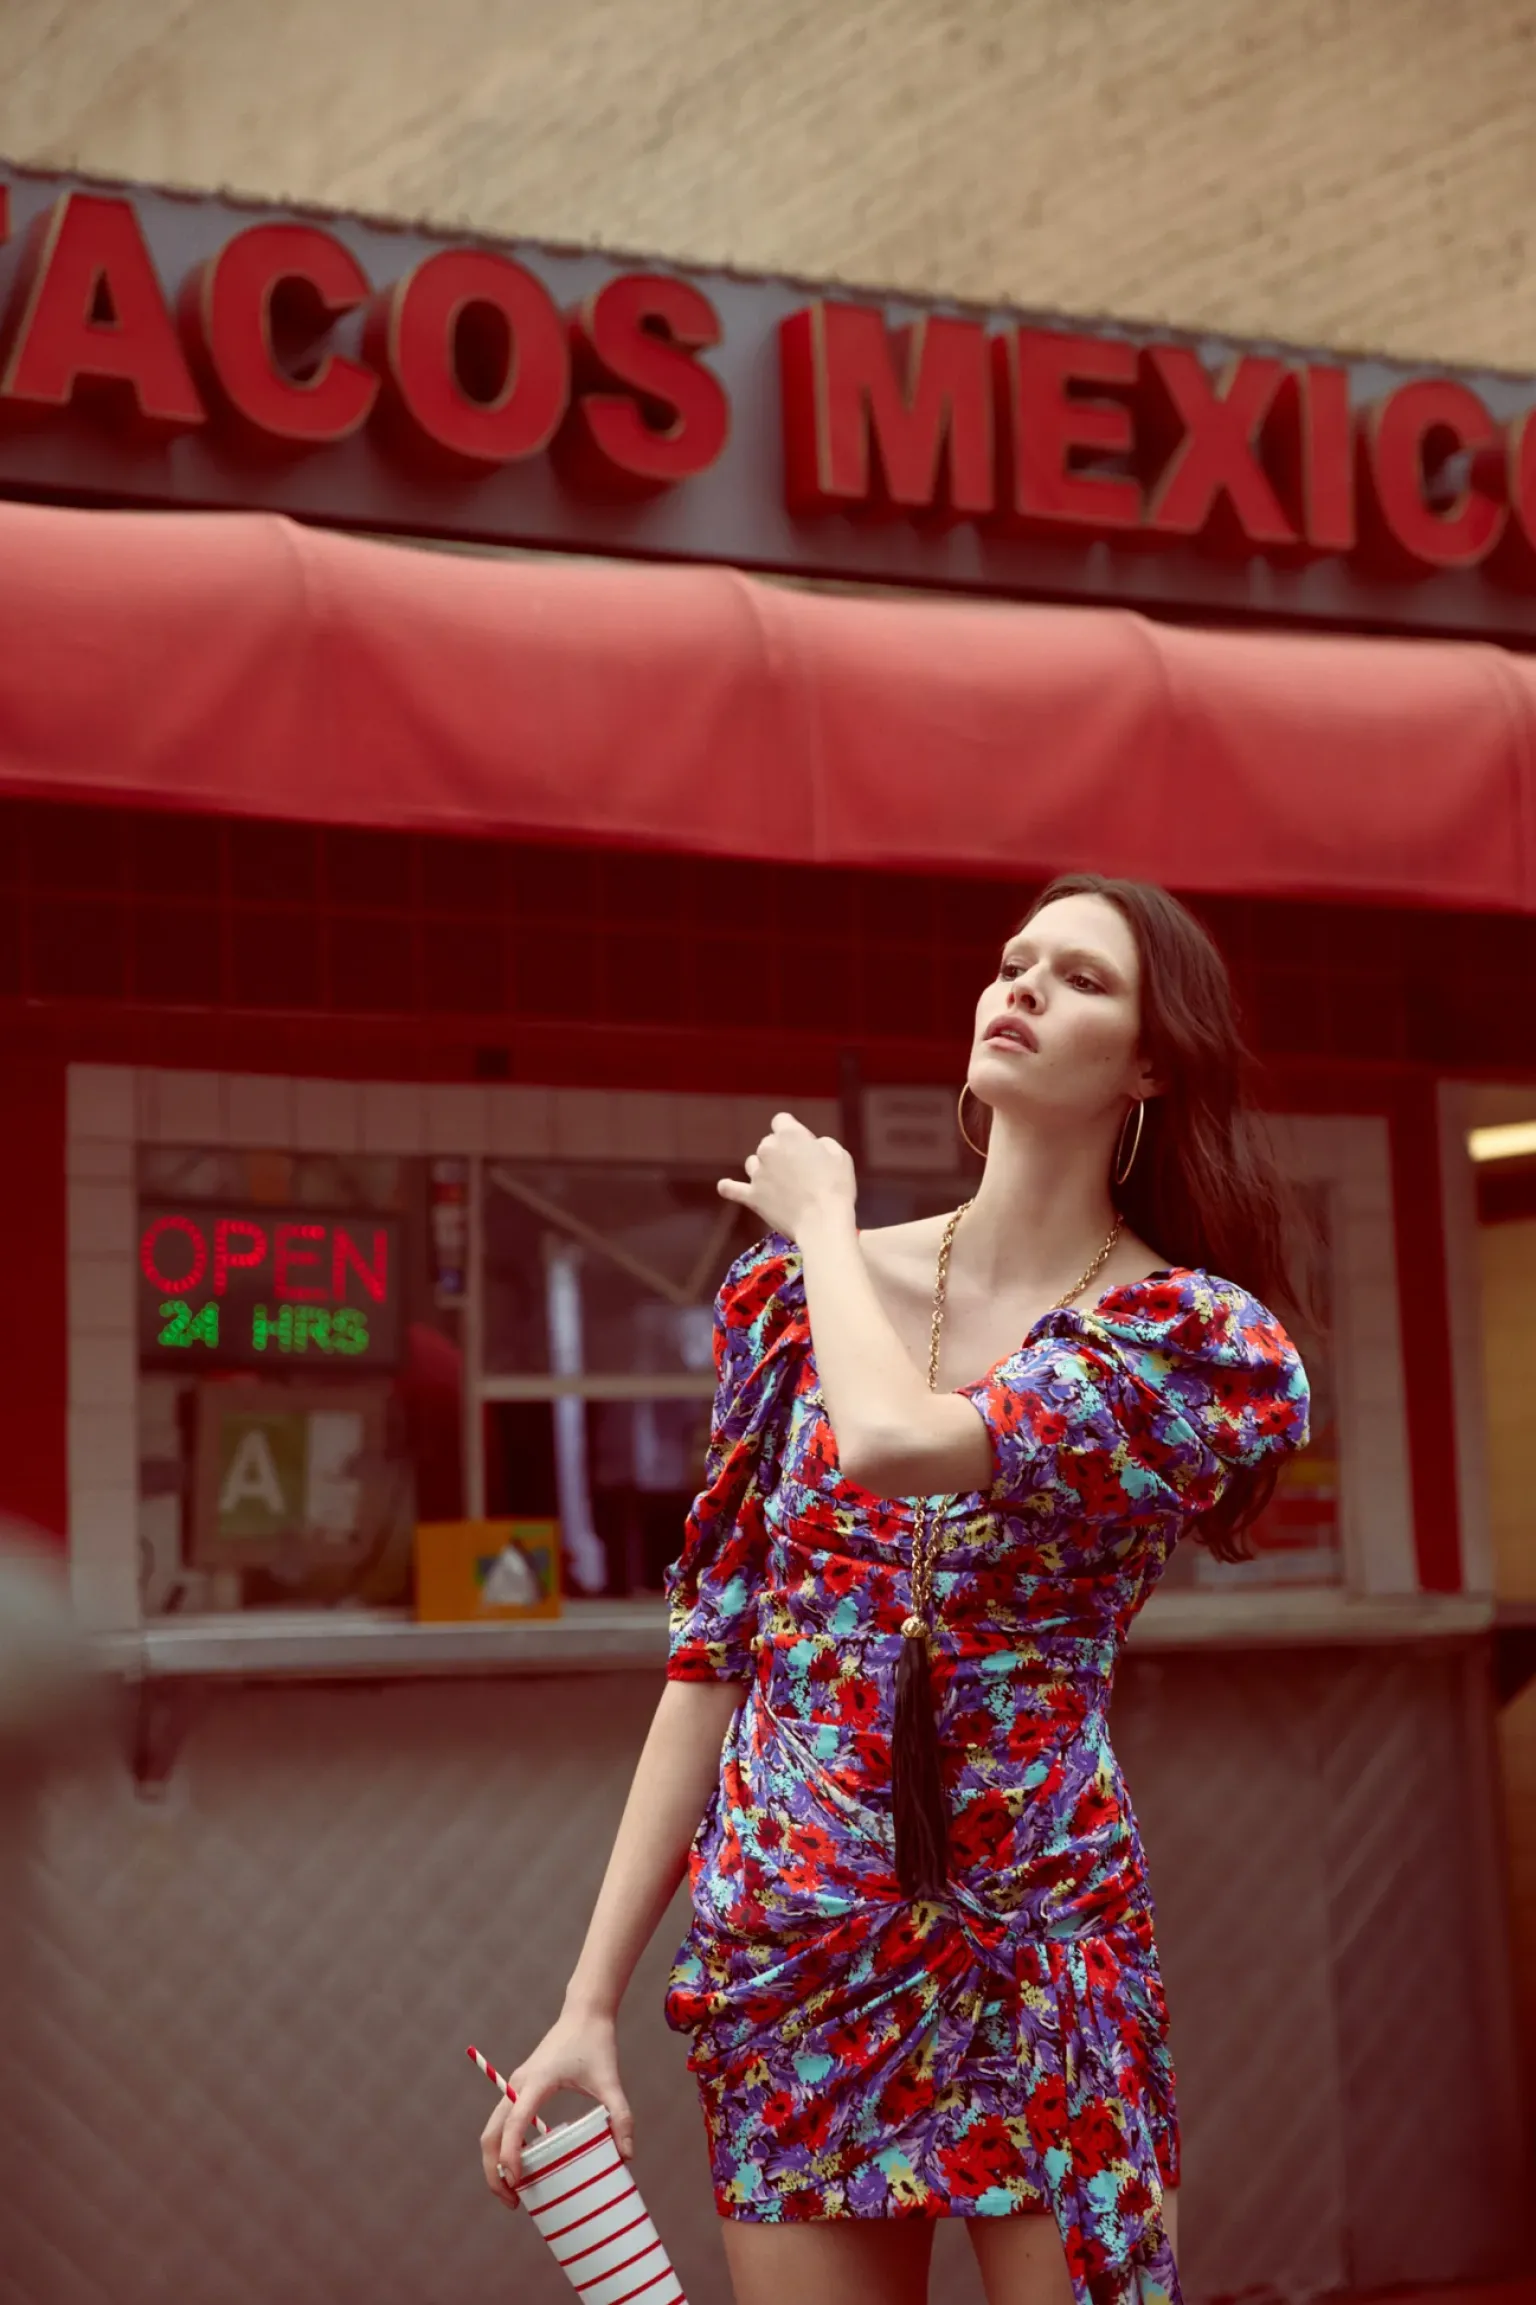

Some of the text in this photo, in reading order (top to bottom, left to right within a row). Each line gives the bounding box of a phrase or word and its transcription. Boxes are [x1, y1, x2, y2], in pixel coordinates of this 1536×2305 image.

[0, 182, 1536, 568] ACOS MEXIC
[140, 1215, 388, 1304] OPEN
[158, 1301, 369, 1354] 24 HRS
[219, 1429, 285, 1516] A
